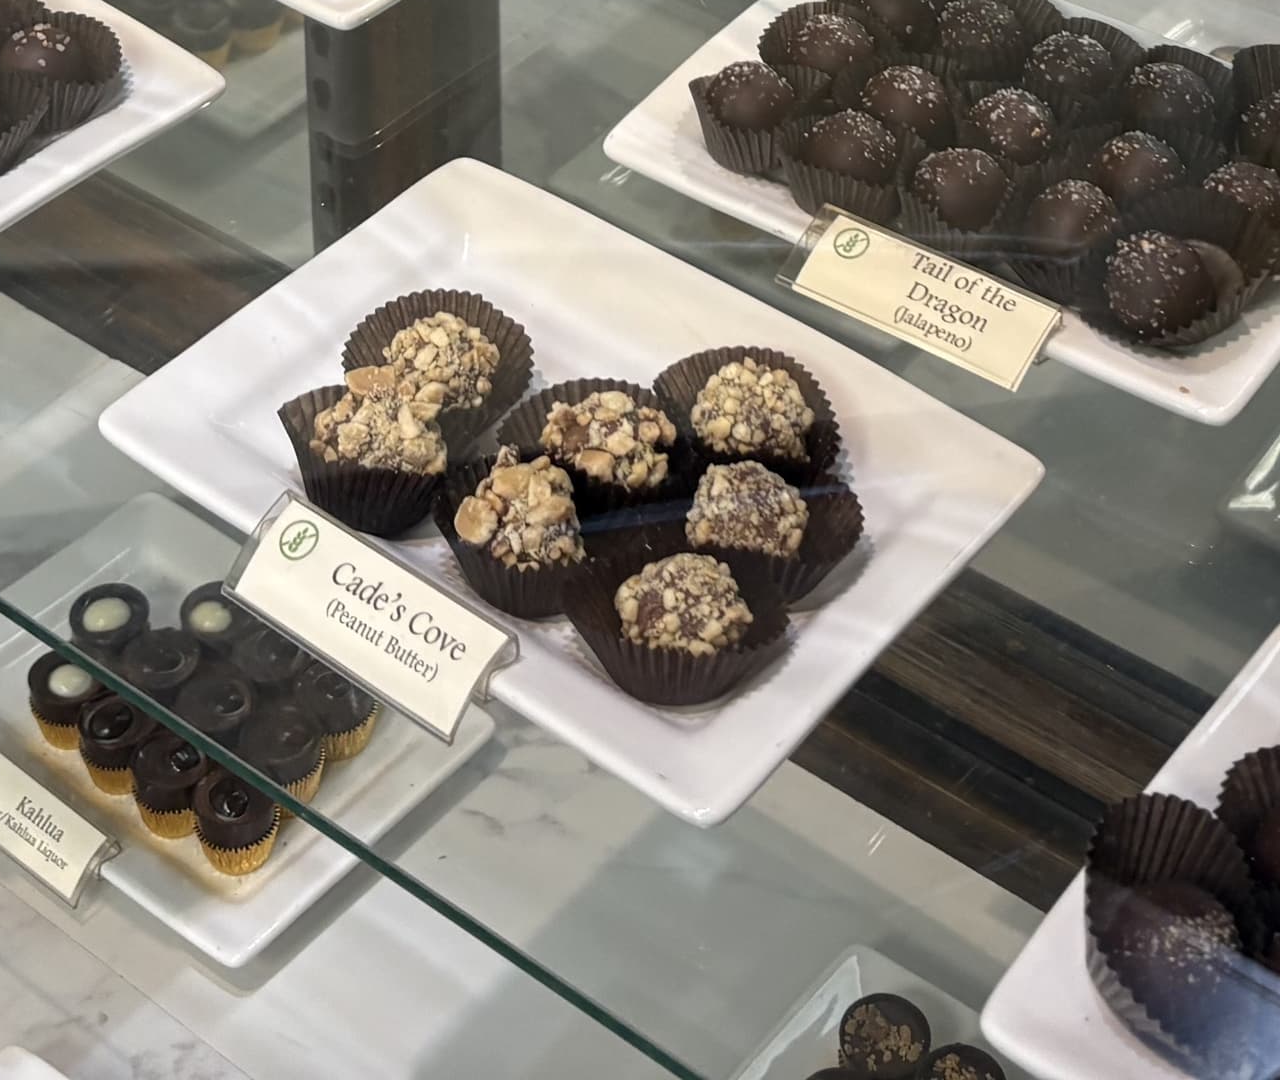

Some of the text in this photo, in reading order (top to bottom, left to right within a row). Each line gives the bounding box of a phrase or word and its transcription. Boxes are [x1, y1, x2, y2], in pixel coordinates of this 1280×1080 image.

[905, 281, 989, 334] Dragon
[911, 251, 1018, 314] Tail of the
[893, 305, 974, 353] (Jalapeno)
[331, 561, 467, 662] Cade's Cove
[326, 598, 440, 683] (Peanut Butter)
[15, 796, 65, 844] Kahlua
[36, 840, 69, 870] Liquor
